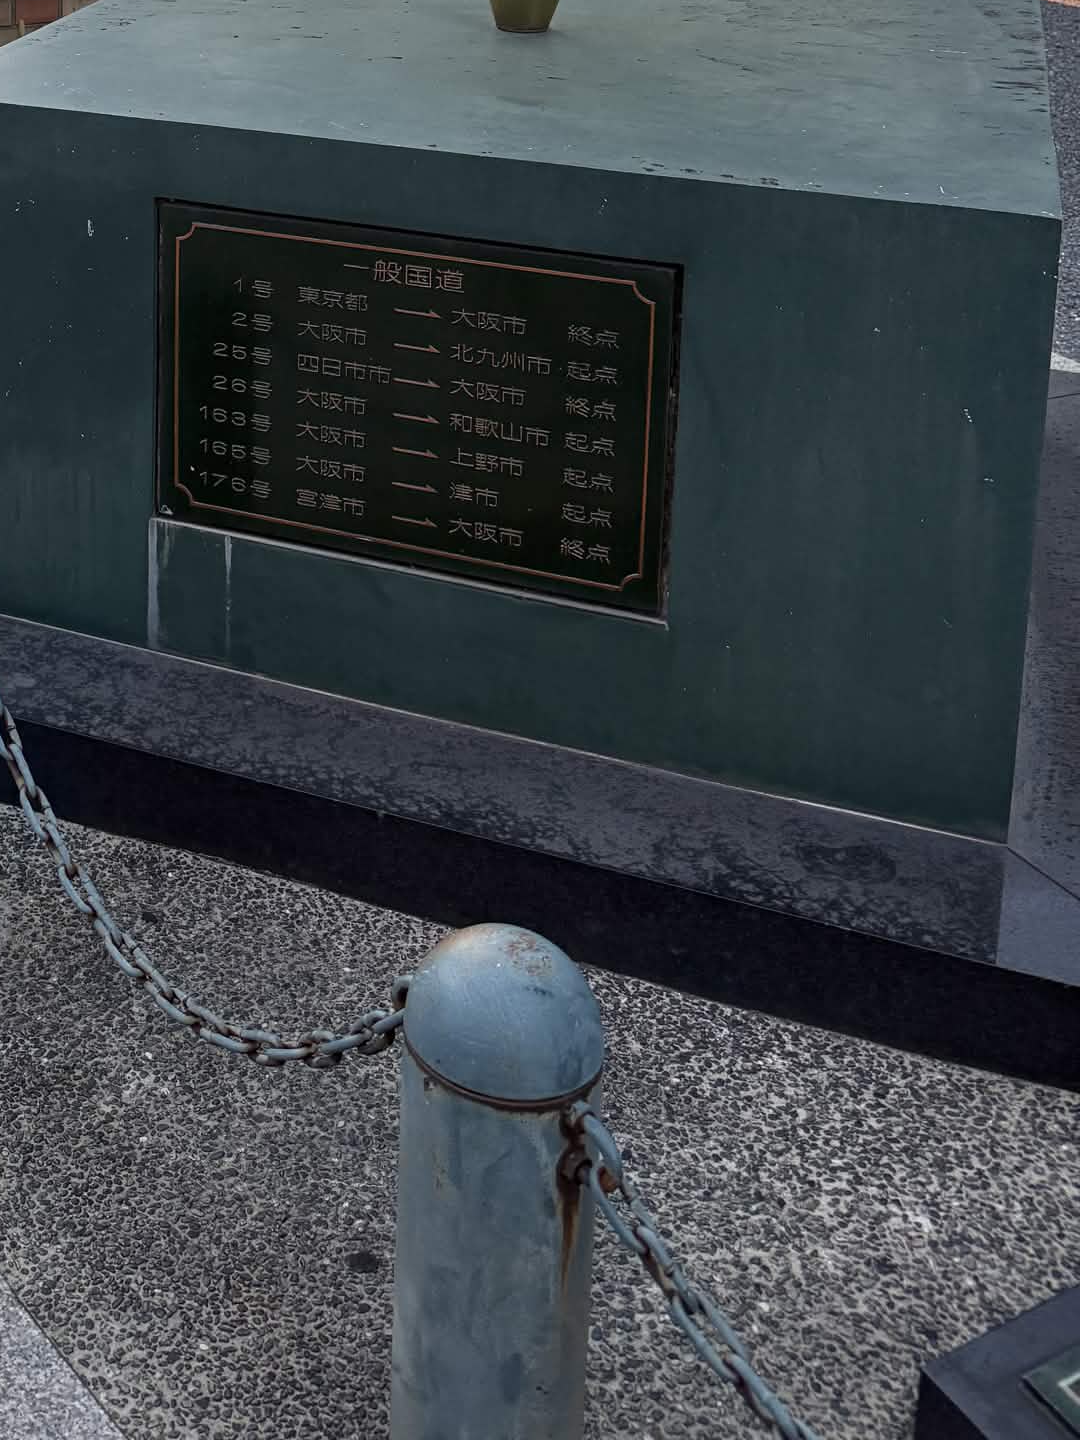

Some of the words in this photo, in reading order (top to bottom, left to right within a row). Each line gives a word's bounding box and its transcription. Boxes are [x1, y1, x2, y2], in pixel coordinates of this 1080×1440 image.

[233, 277, 274, 299] 1号
[297, 285, 368, 312] 東京都
[451, 308, 528, 335] 大阪市
[568, 324, 620, 350] 終点
[343, 259, 465, 294] 一般国道
[212, 342, 273, 366] 25号
[297, 353, 392, 384] 四日市市
[449, 378, 527, 407] 大阪市
[565, 396, 617, 422] 終点
[231, 312, 273, 332] 2号
[297, 320, 368, 346] 大阪市
[449, 344, 552, 375] 北九州市
[567, 361, 618, 385] 起点
[199, 405, 272, 432] 163号
[296, 421, 367, 448] 大阪市
[449, 448, 525, 478] 上野市
[561, 467, 615, 493] 起点
[212, 375, 273, 399] 26号
[296, 388, 368, 416] 大阪市
[448, 413, 552, 447] 和歌山市
[563, 432, 616, 457] 起点
[199, 438, 272, 465] 165号
[296, 455, 367, 482] 大阪市
[449, 482, 500, 508] 津市
[560, 502, 613, 529] 起点
[199, 471, 272, 499] 176号
[296, 488, 367, 517] 宮津市
[448, 517, 525, 547] 大阪市
[559, 536, 612, 565] 終点
